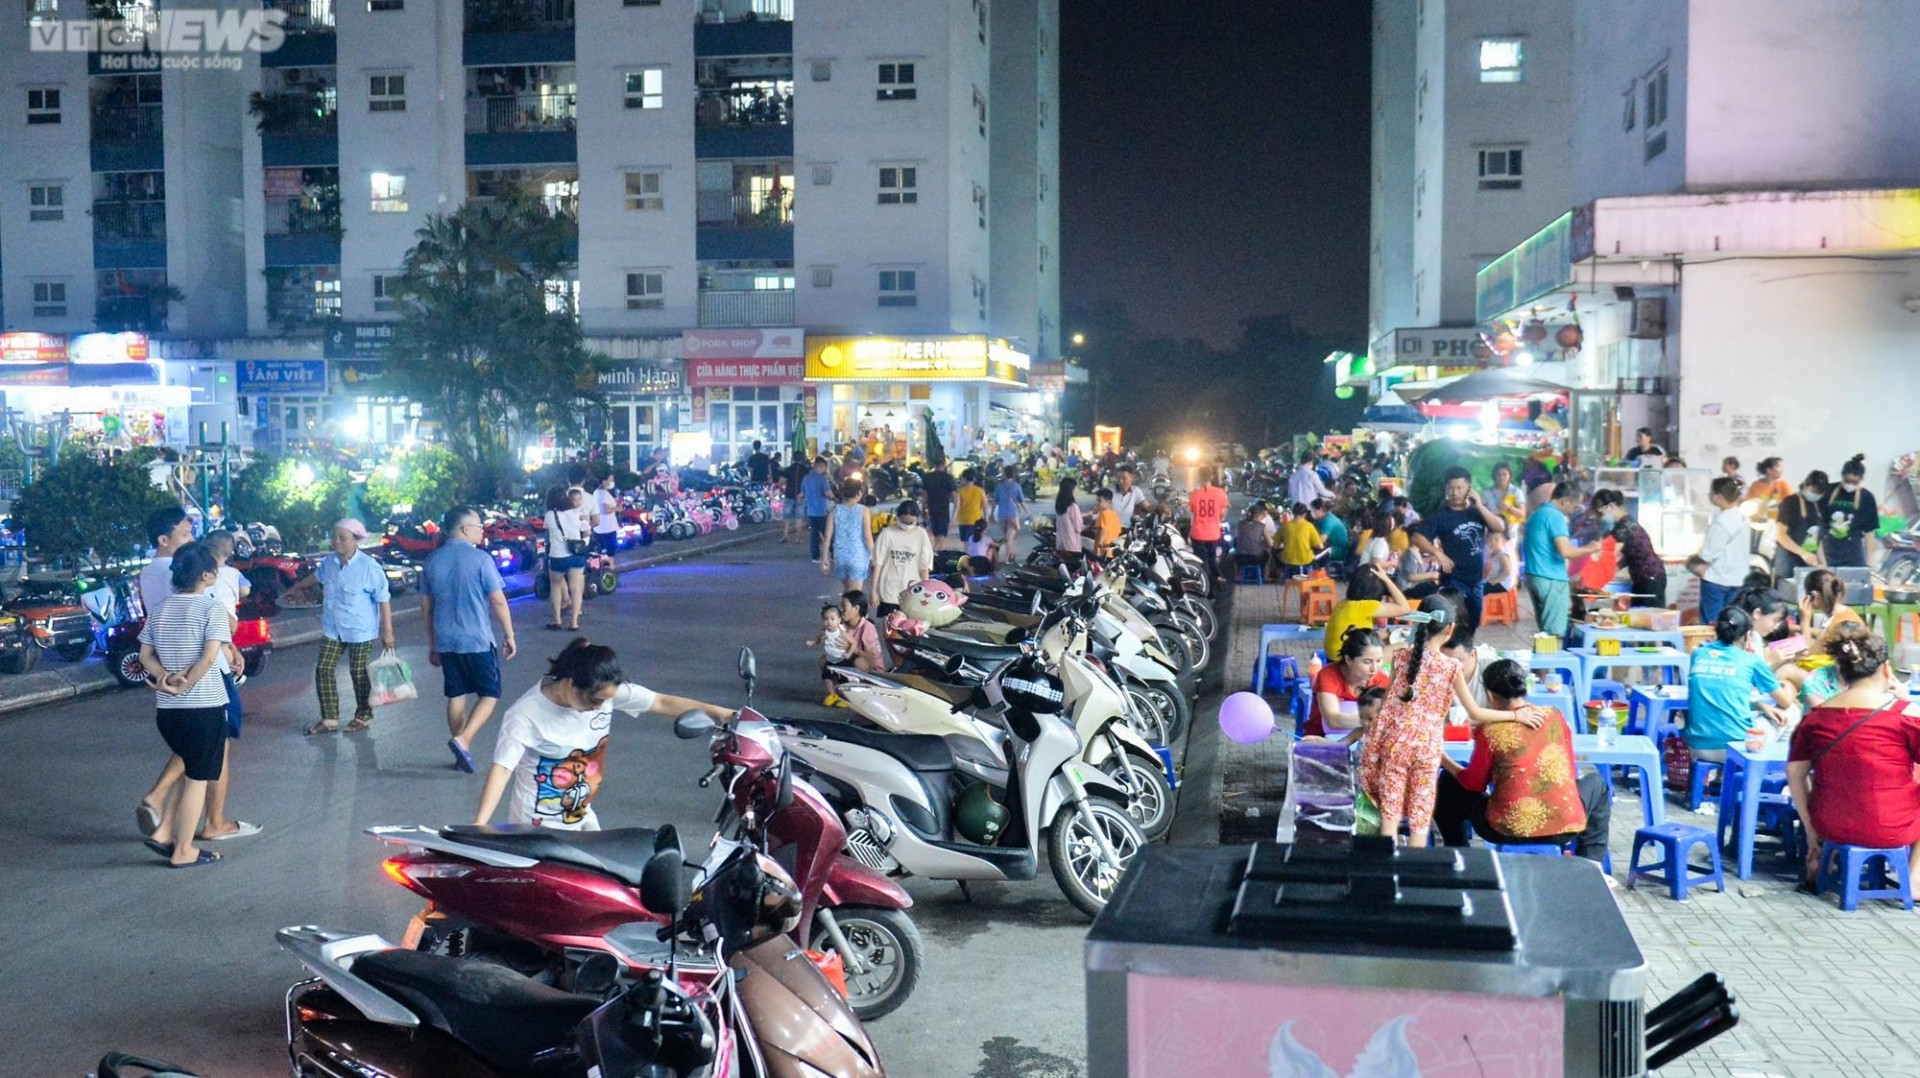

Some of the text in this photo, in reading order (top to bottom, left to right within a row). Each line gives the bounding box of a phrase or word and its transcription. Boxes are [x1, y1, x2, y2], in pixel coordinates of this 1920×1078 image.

[702, 339, 757, 348] PORK SHOP
[247, 367, 314, 382] TÂM VIỆT
[696, 362, 713, 377] CỬA
[715, 363, 737, 377] HÀNG
[739, 364, 760, 379] THỰC
[762, 360, 786, 377] PHẨM
[1199, 499, 1215, 517] 88
